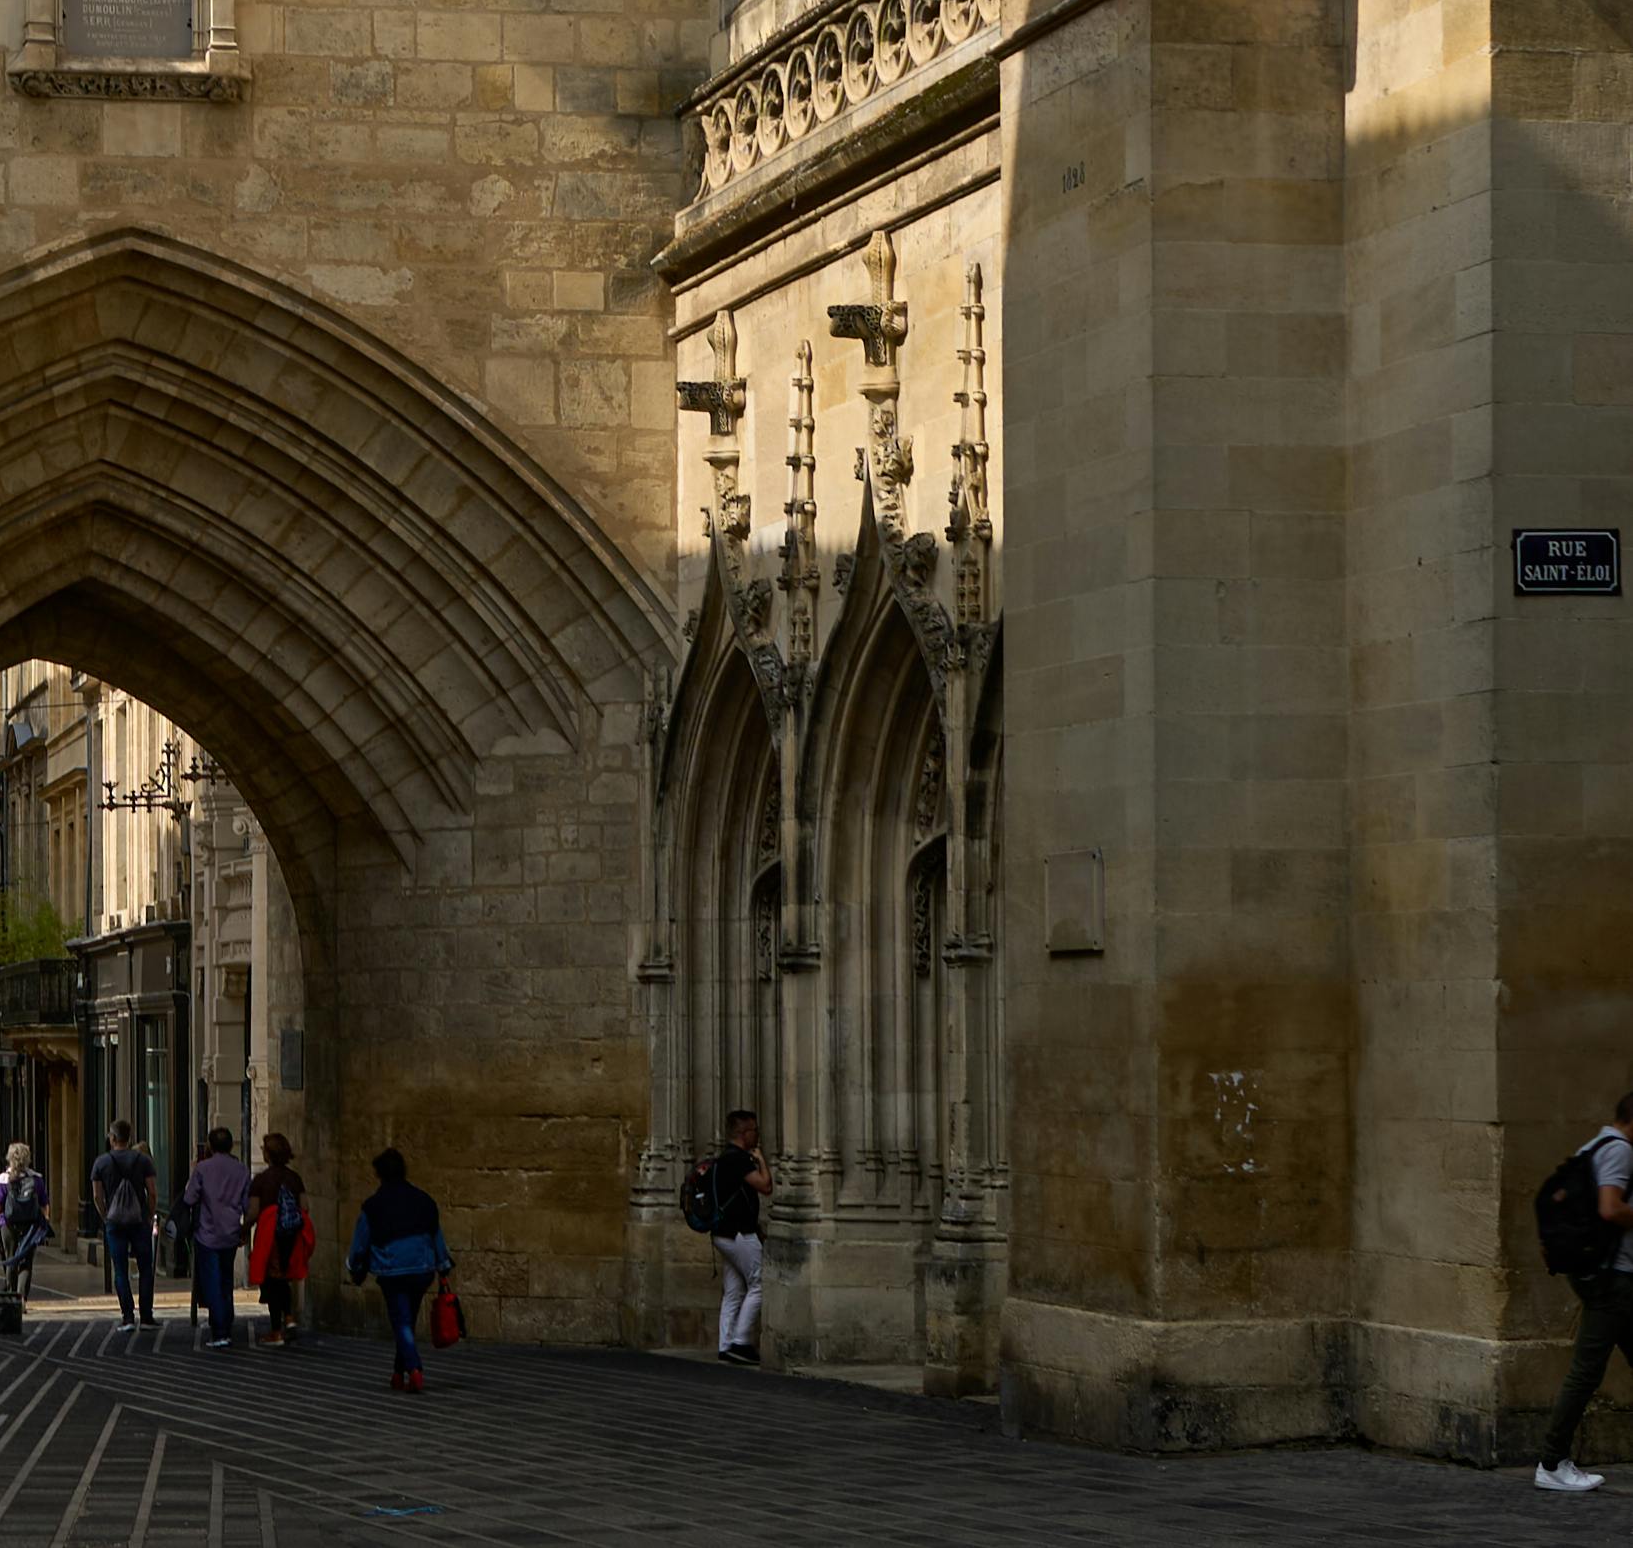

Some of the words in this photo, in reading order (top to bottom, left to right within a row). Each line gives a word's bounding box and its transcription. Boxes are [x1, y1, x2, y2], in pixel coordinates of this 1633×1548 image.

[82, 4, 132, 15] DUMOULIN
[1548, 540, 1587, 557] RUE
[1524, 561, 1611, 581] SAINT-ÉLOI
